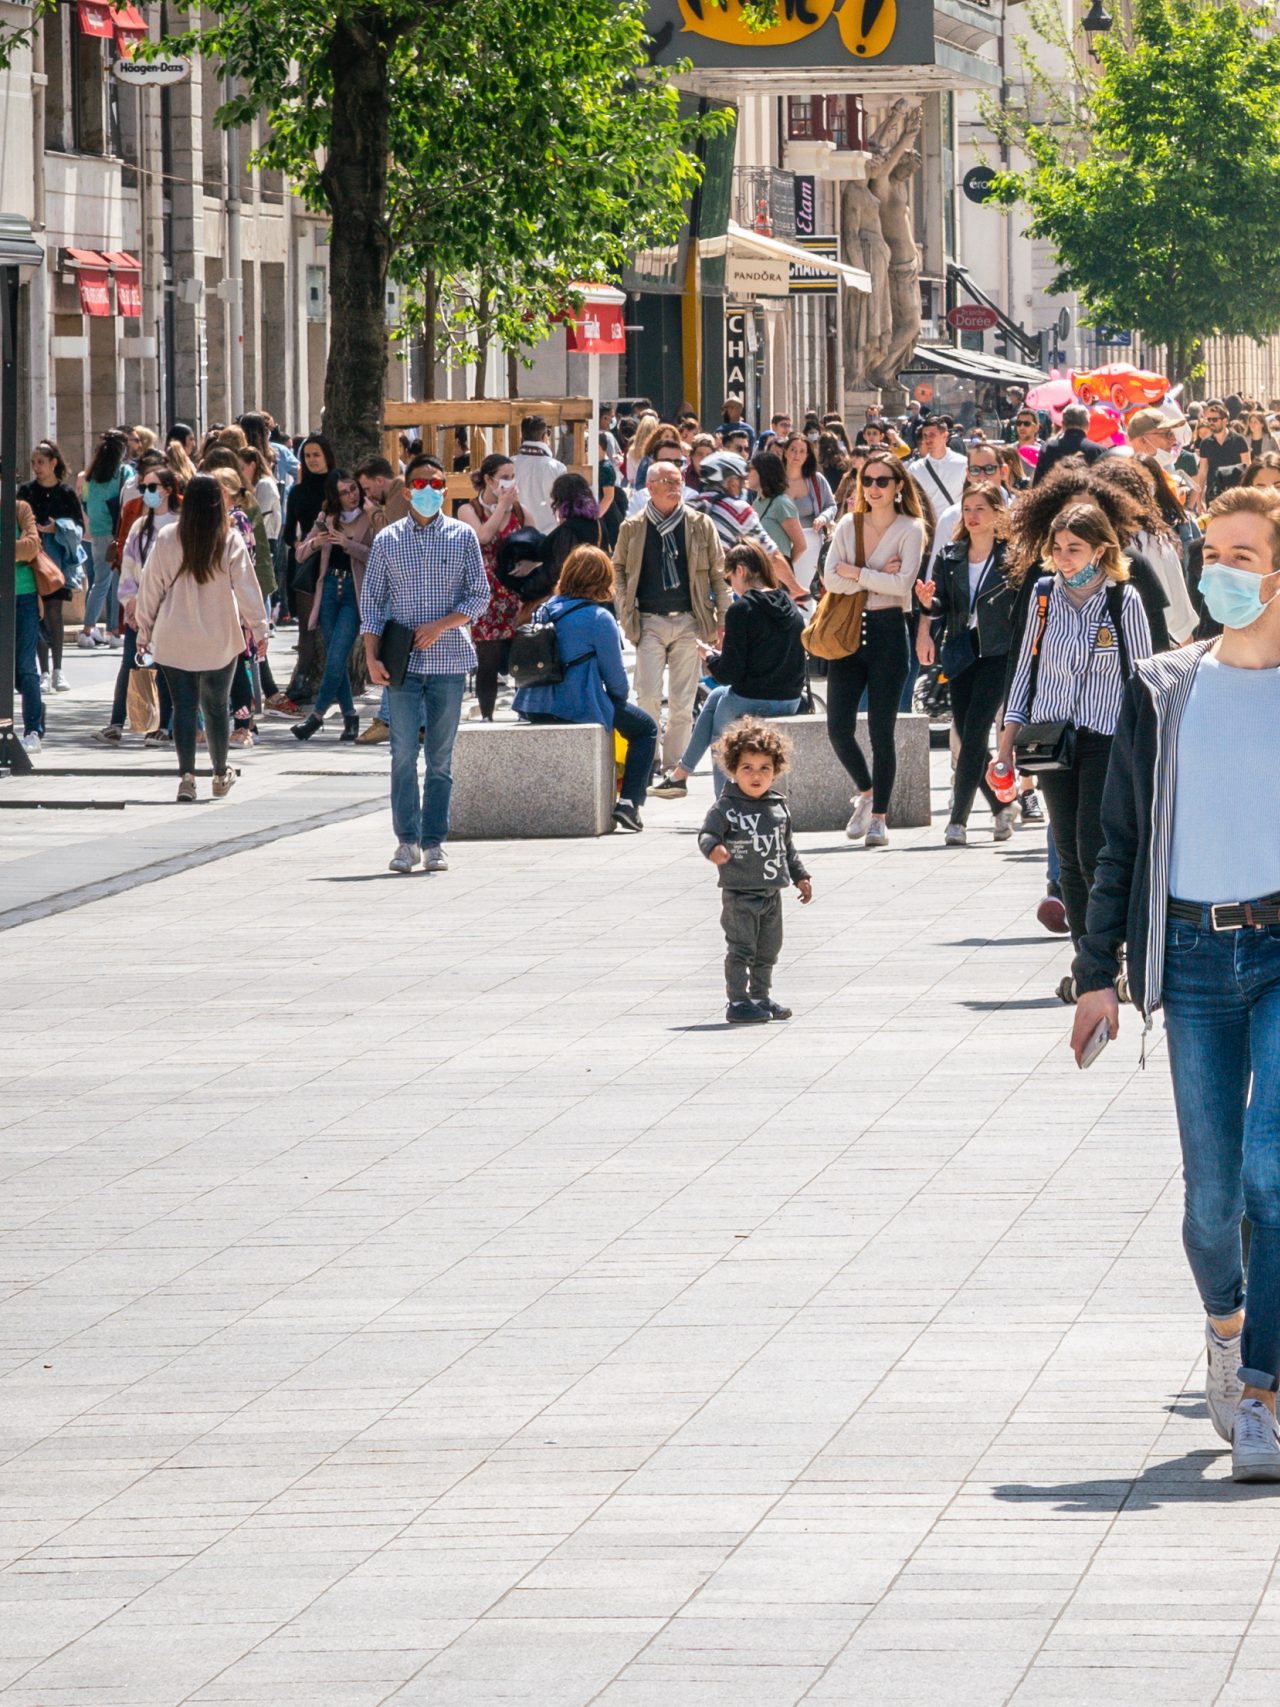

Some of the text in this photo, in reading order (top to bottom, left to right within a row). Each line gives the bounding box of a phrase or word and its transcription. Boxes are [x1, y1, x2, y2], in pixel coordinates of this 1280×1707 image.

[120, 62, 184, 75] Häagen-Dazs
[797, 181, 813, 233] Etam
[728, 315, 745, 407] CHAN
